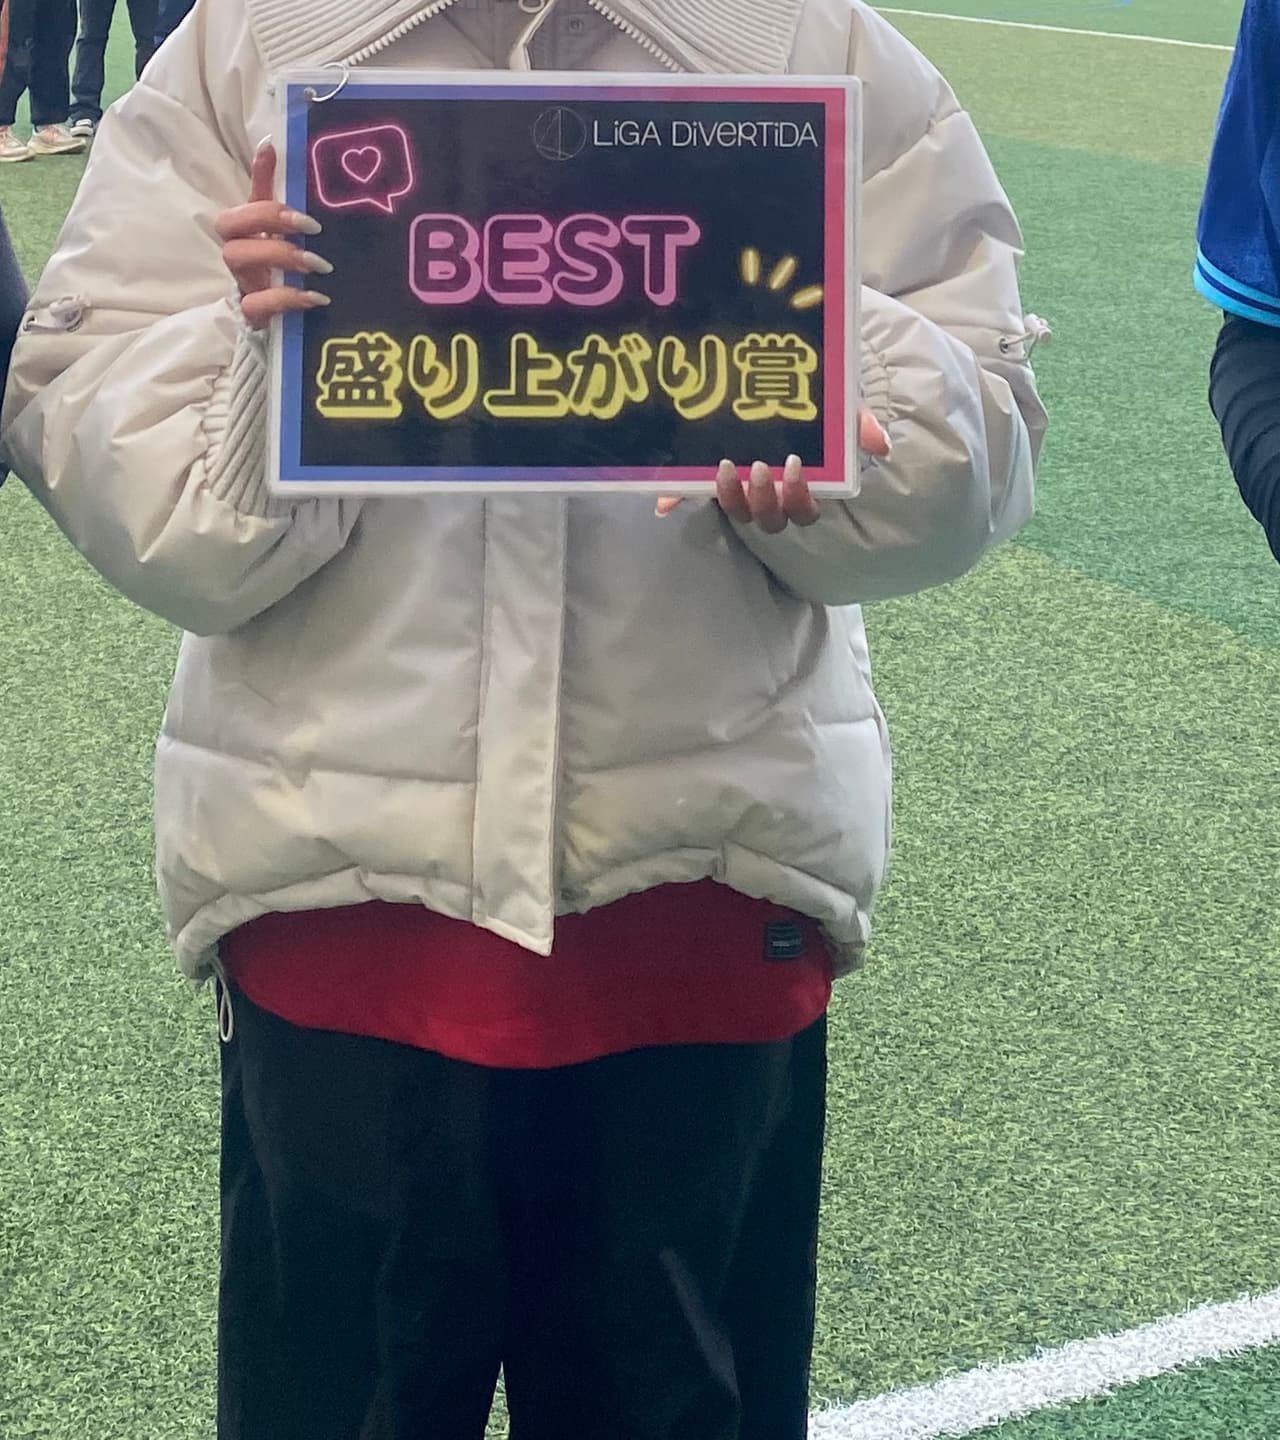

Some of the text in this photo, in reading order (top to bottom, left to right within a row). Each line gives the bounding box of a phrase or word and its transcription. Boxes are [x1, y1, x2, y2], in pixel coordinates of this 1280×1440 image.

[408, 213, 701, 307] BEST
[316, 332, 818, 422] 盛り上がり賞
